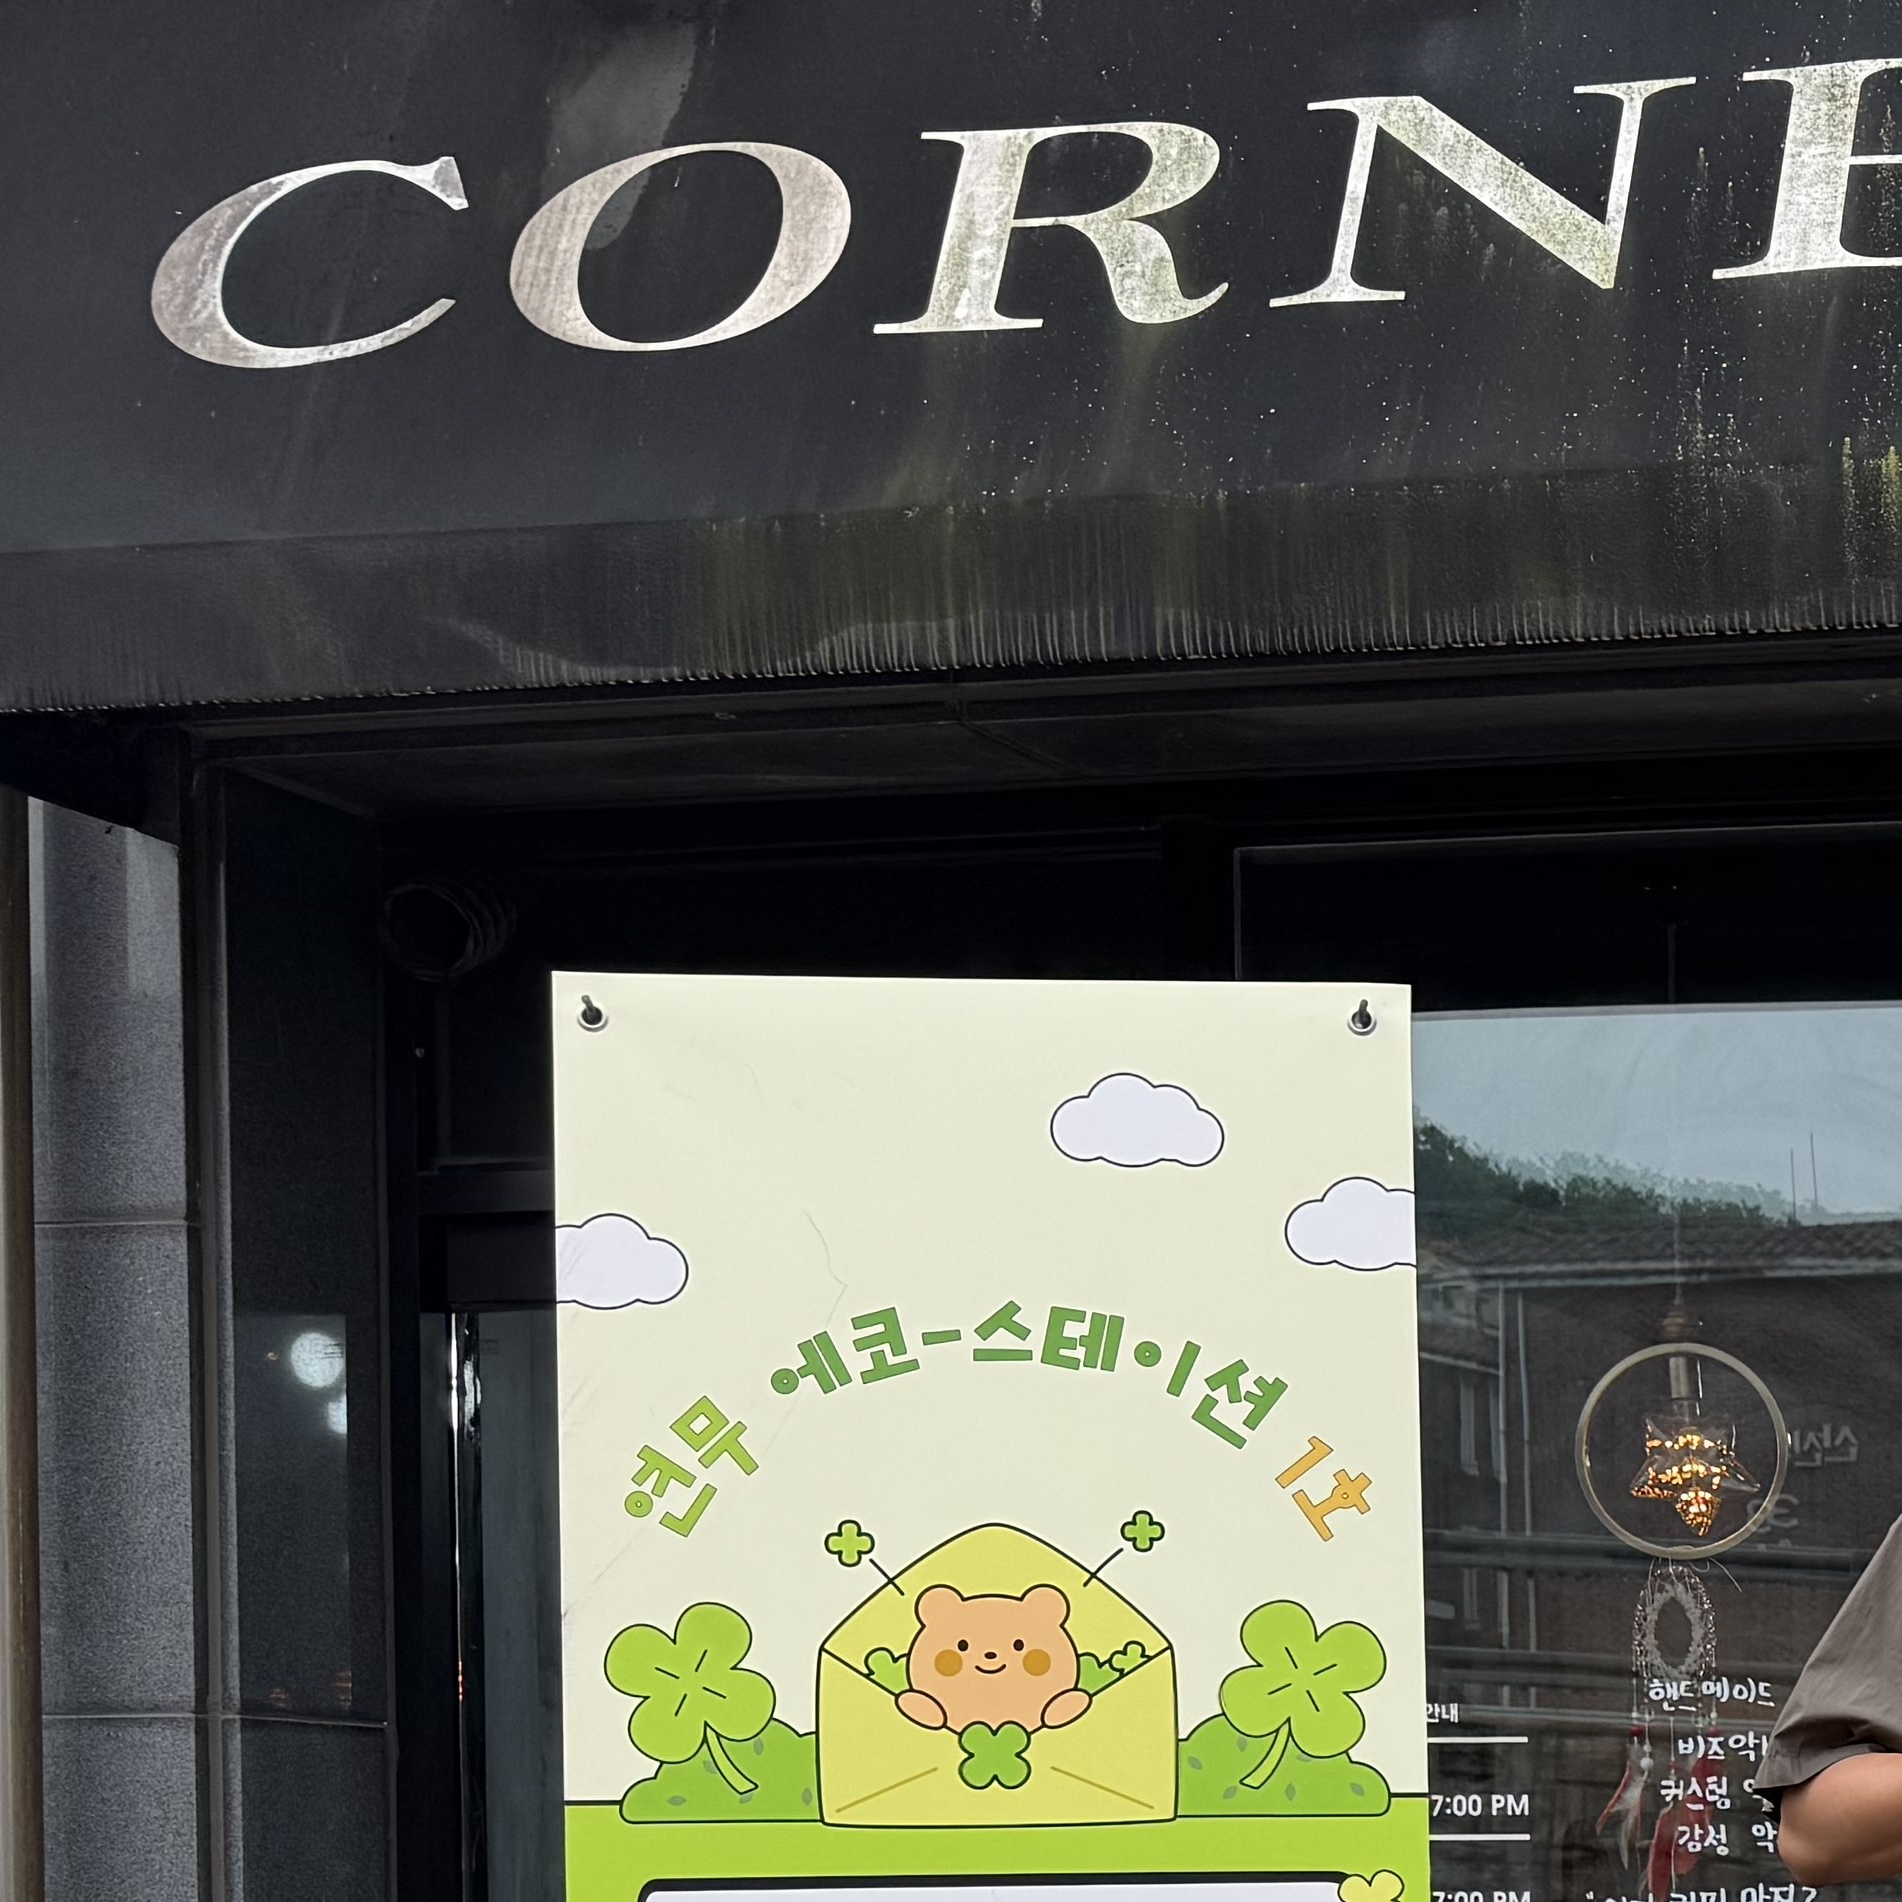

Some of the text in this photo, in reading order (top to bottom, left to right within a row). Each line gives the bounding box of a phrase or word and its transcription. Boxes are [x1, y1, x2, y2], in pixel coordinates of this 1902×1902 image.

[624, 1300, 1373, 1543] 연무 에코-스테이션 1호
[1649, 1676, 1775, 1712] 핸드메이드
[1431, 1794, 1530, 1817] 7:00 PM
[1678, 1824, 1729, 1856] 감성
